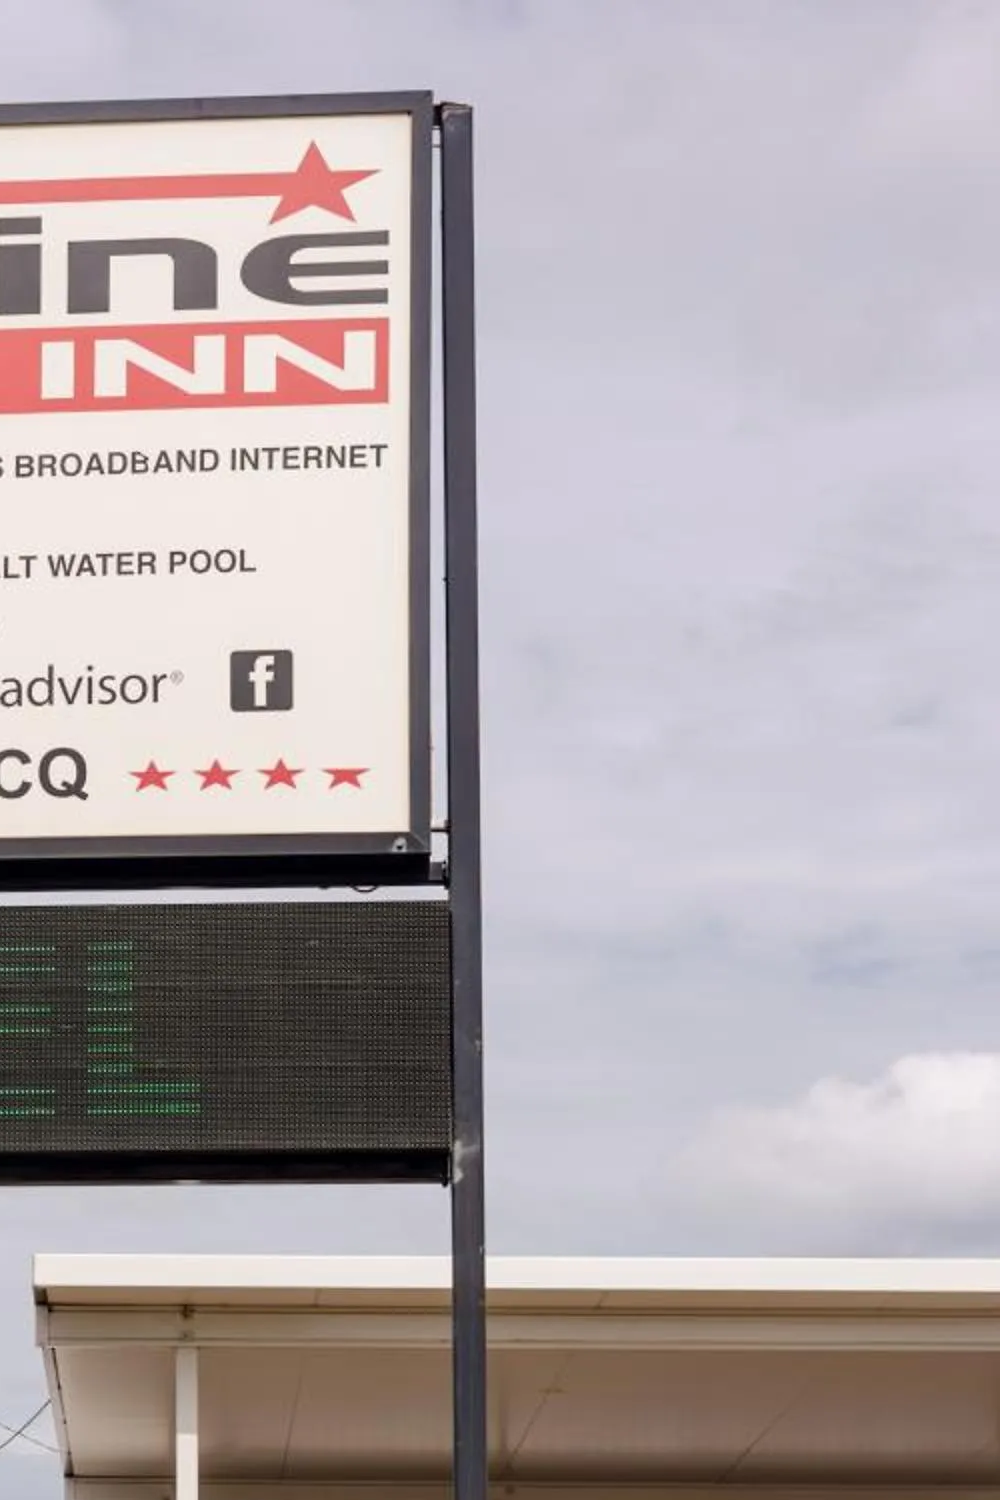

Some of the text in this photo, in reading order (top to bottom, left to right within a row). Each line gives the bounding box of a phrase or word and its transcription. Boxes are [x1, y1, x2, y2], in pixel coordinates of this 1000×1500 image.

[40, 329, 377, 400] INN
[15, 448, 220, 479] BROADBAND
[230, 444, 389, 471] INTERNET
[47, 551, 157, 578] WATER
[169, 548, 257, 575] POOL
